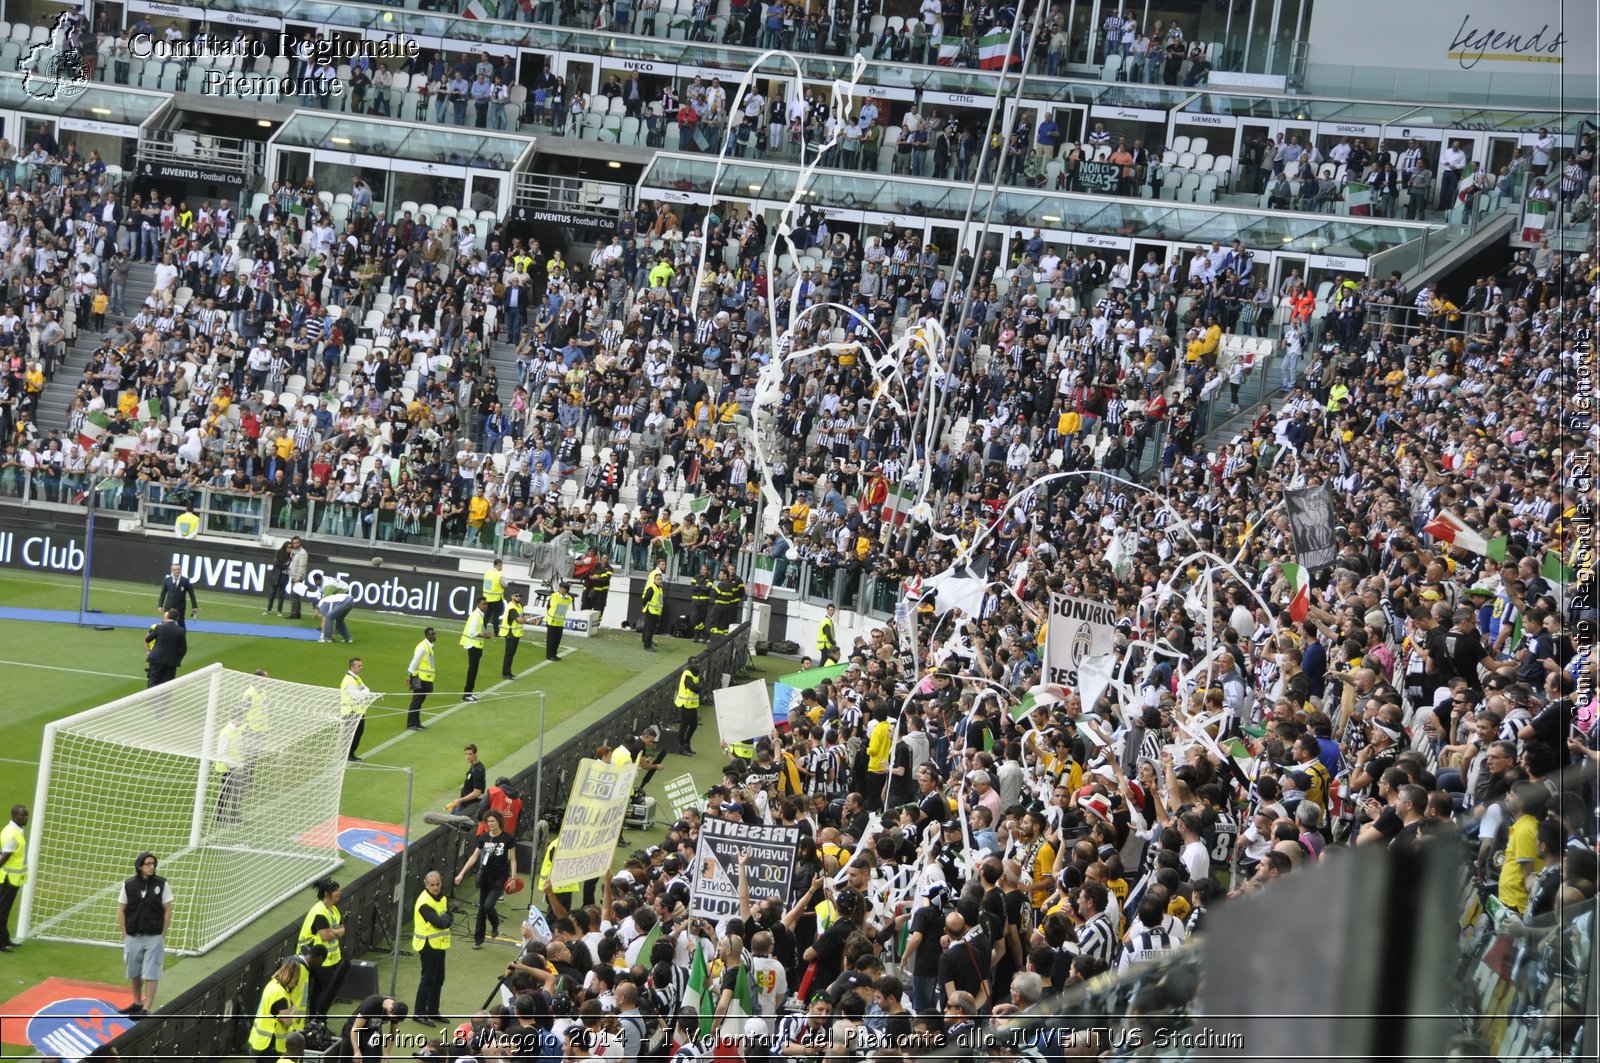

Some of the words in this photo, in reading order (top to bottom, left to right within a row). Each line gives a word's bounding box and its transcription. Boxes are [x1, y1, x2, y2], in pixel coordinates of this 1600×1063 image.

[624, 62, 654, 71] IVECO
[948, 94, 974, 104] CMG
[1191, 116, 1222, 124] SIEMENS
[1080, 161, 1100, 174] NON
[160, 167, 198, 179] JUVENTUS
[200, 172, 226, 182] Football
[228, 174, 242, 184] Club
[1078, 172, 1103, 185] SENZA
[534, 211, 571, 224] JUVENTUS
[572, 216, 598, 227] Football
[600, 218, 614, 229] Club
[22, 536, 84, 571] Club
[572, 620, 587, 632] HD
[1212, 833, 1230, 861] 8
